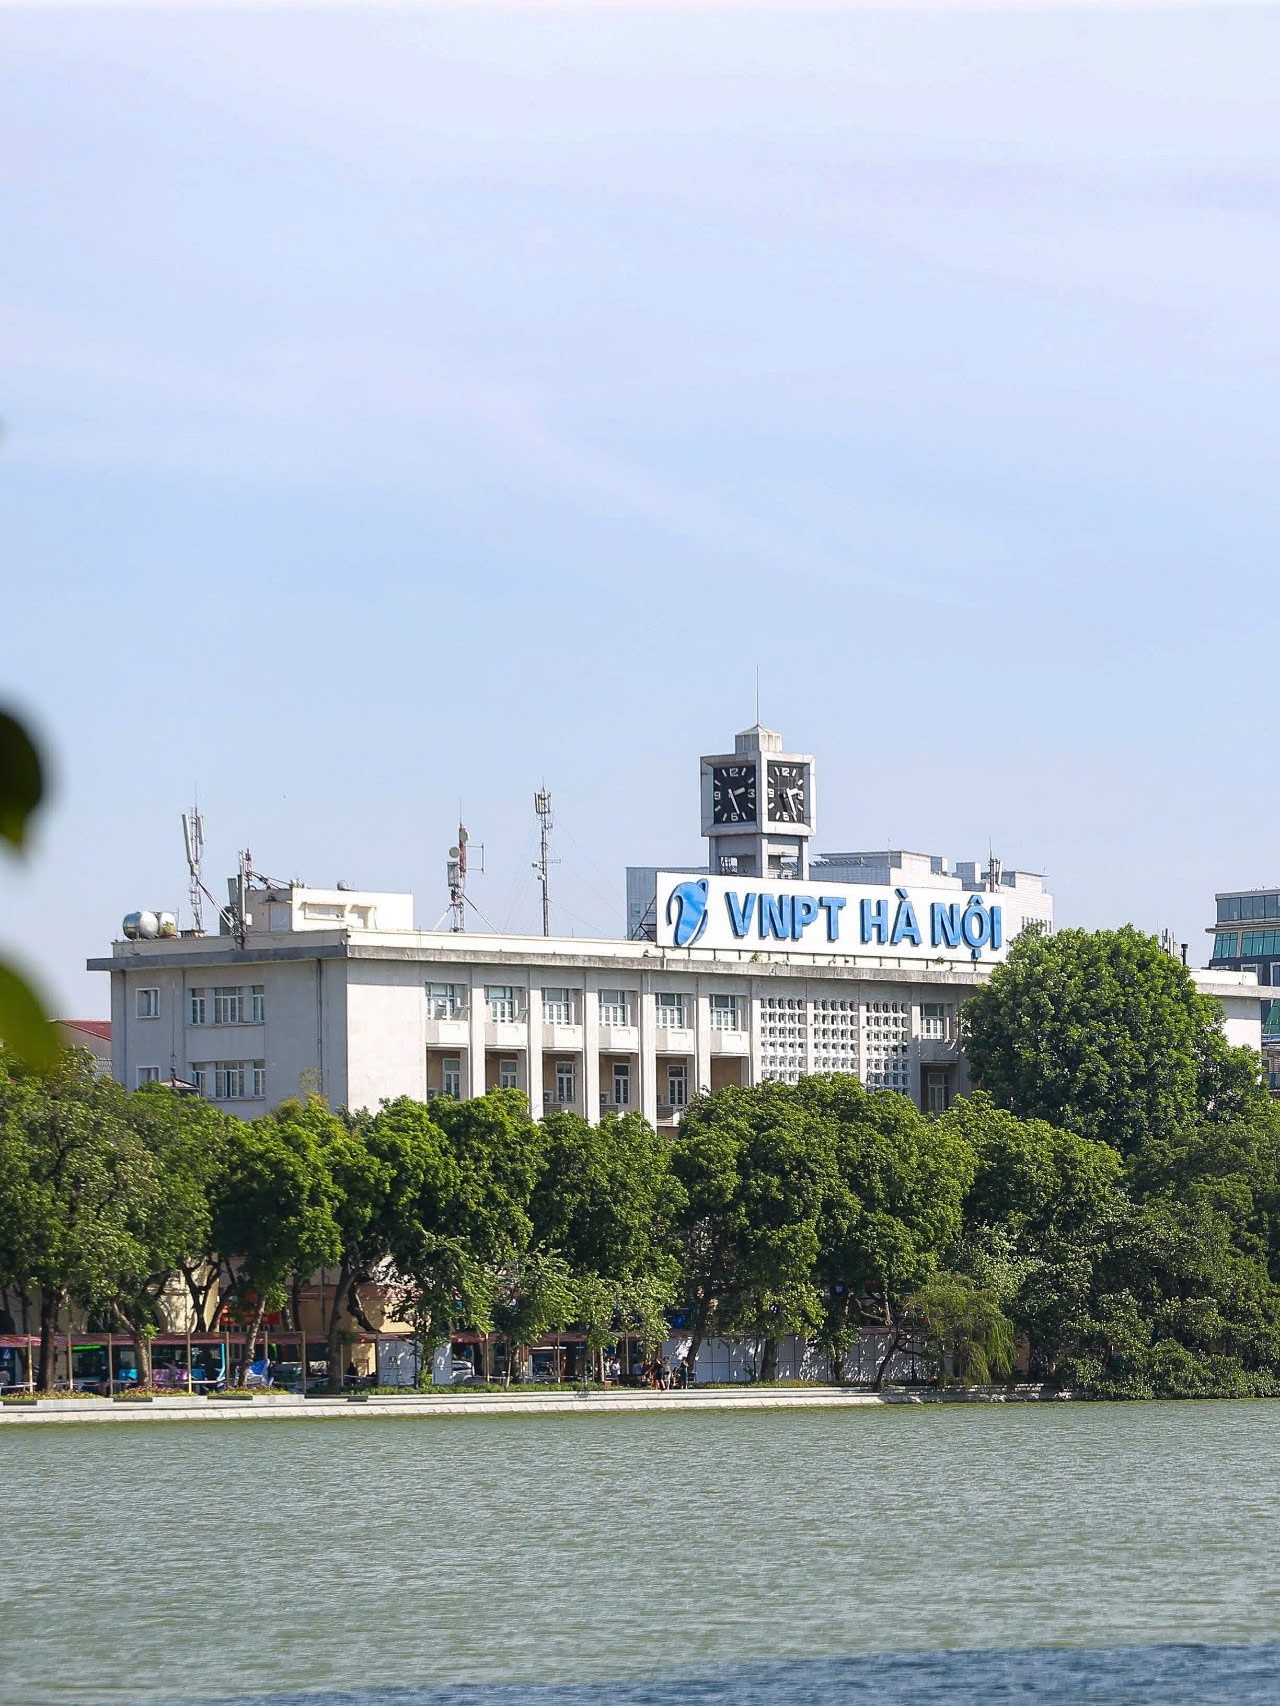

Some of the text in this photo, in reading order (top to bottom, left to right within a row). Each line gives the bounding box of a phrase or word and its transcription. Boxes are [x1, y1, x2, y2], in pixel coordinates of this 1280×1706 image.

[729, 768, 739, 777] 12
[781, 767, 790, 777] 12
[713, 788, 755, 800] 9 3
[767, 788, 804, 800] 9 3
[730, 812, 738, 821] 6
[782, 811, 790, 821] 6
[724, 888, 1002, 960] VNPT HÀ NỘI
